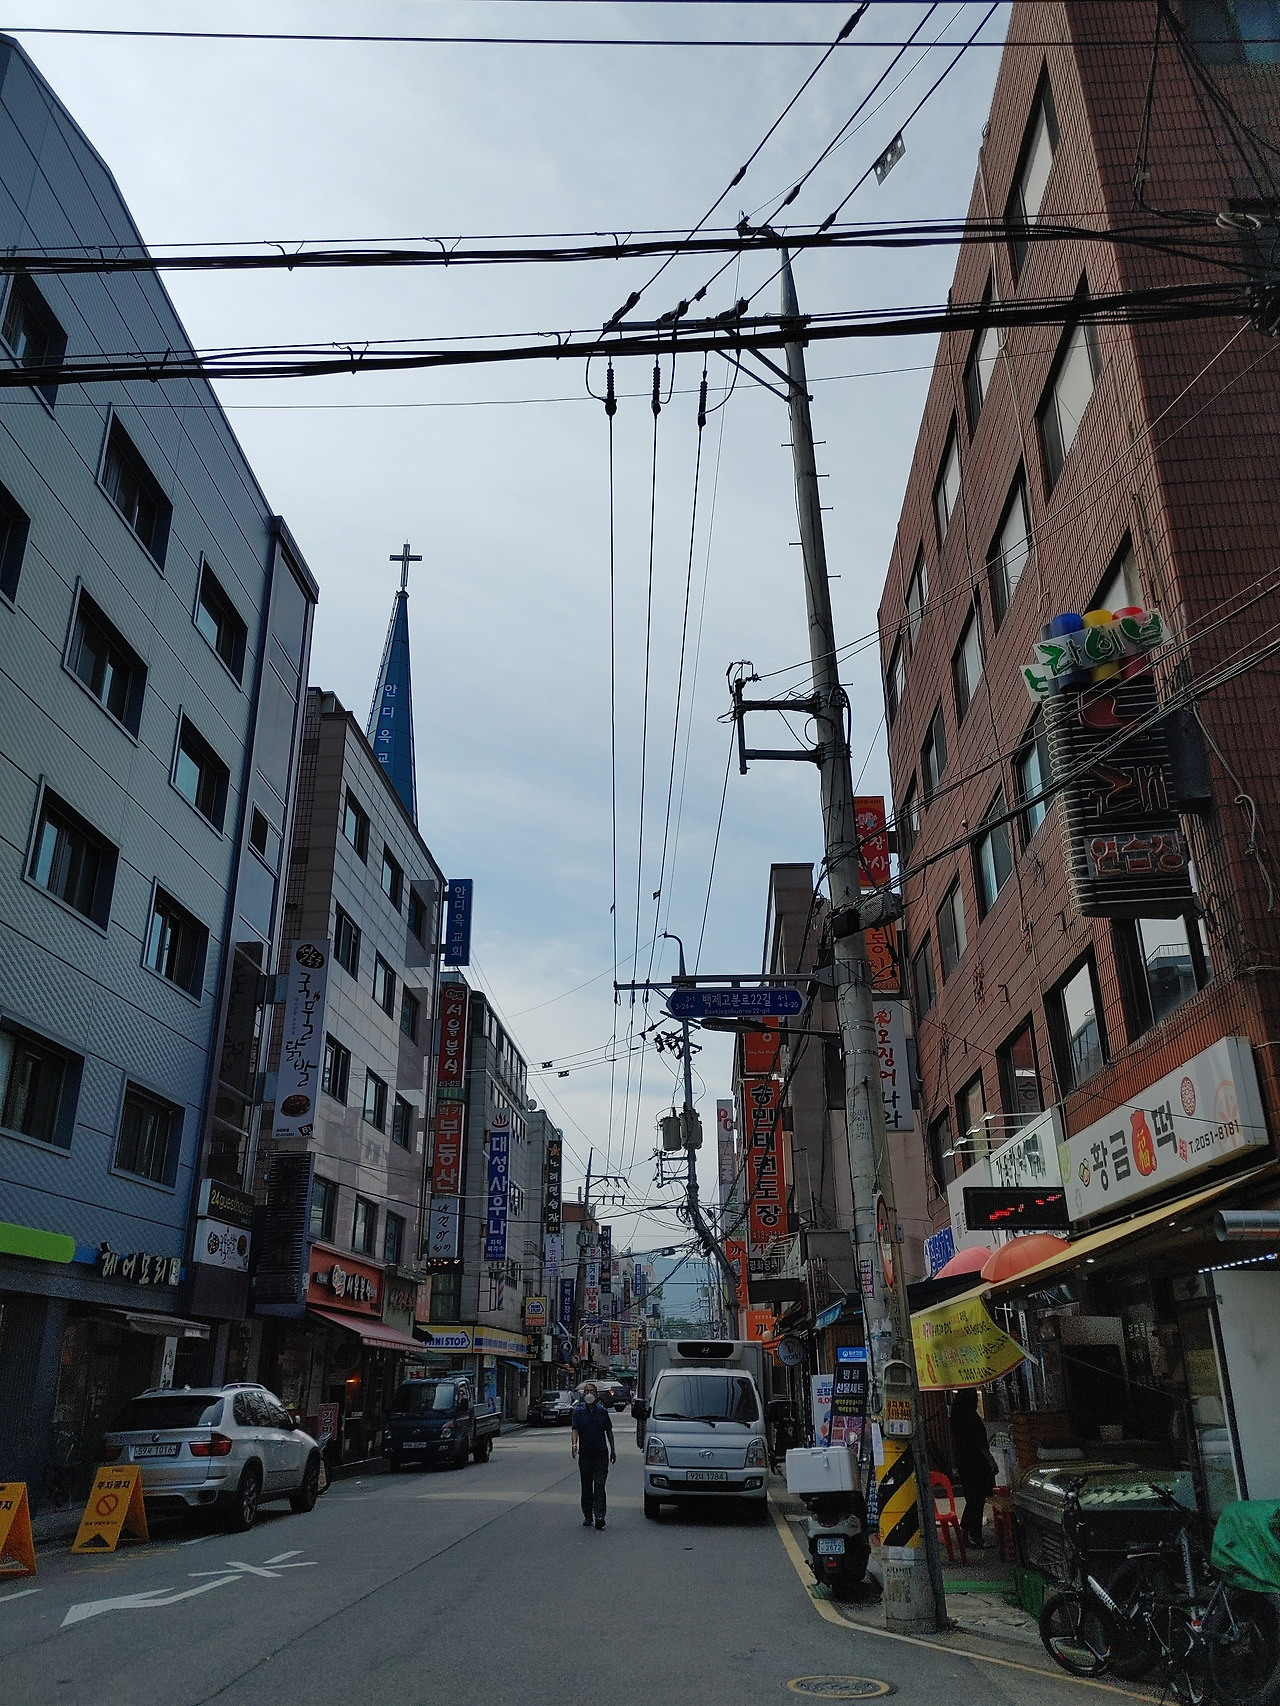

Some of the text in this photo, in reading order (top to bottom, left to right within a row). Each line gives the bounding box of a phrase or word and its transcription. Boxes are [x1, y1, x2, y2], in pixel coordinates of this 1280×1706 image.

[378, 684, 397, 764] 안디옥교
[1089, 830, 1184, 876] 연습장
[451, 886, 467, 957] 안디옥교회
[702, 993, 771, 1008] 백제고분로22길
[704, 1008, 752, 1016] Baekjegobun-ro
[444, 1004, 462, 1075] 서울분식
[877, 1029, 903, 1129] 오징어나라
[717, 1108, 734, 1132] PC
[1188, 1119, 1240, 1155] T.2051-8181
[434, 1118, 460, 1193] 부동산
[1090, 1129, 1131, 1191] 황금
[1151, 1100, 1178, 1154] 떡
[489, 1136, 507, 1236] 대성사우나
[548, 1159, 560, 1223] 노래연습장
[836, 1383, 864, 1394] 선물세트
[843, 1369, 860, 1380] 명절
[155, 1446, 173, 1454] 1016
[97, 1480, 131, 1490] 주차금지
